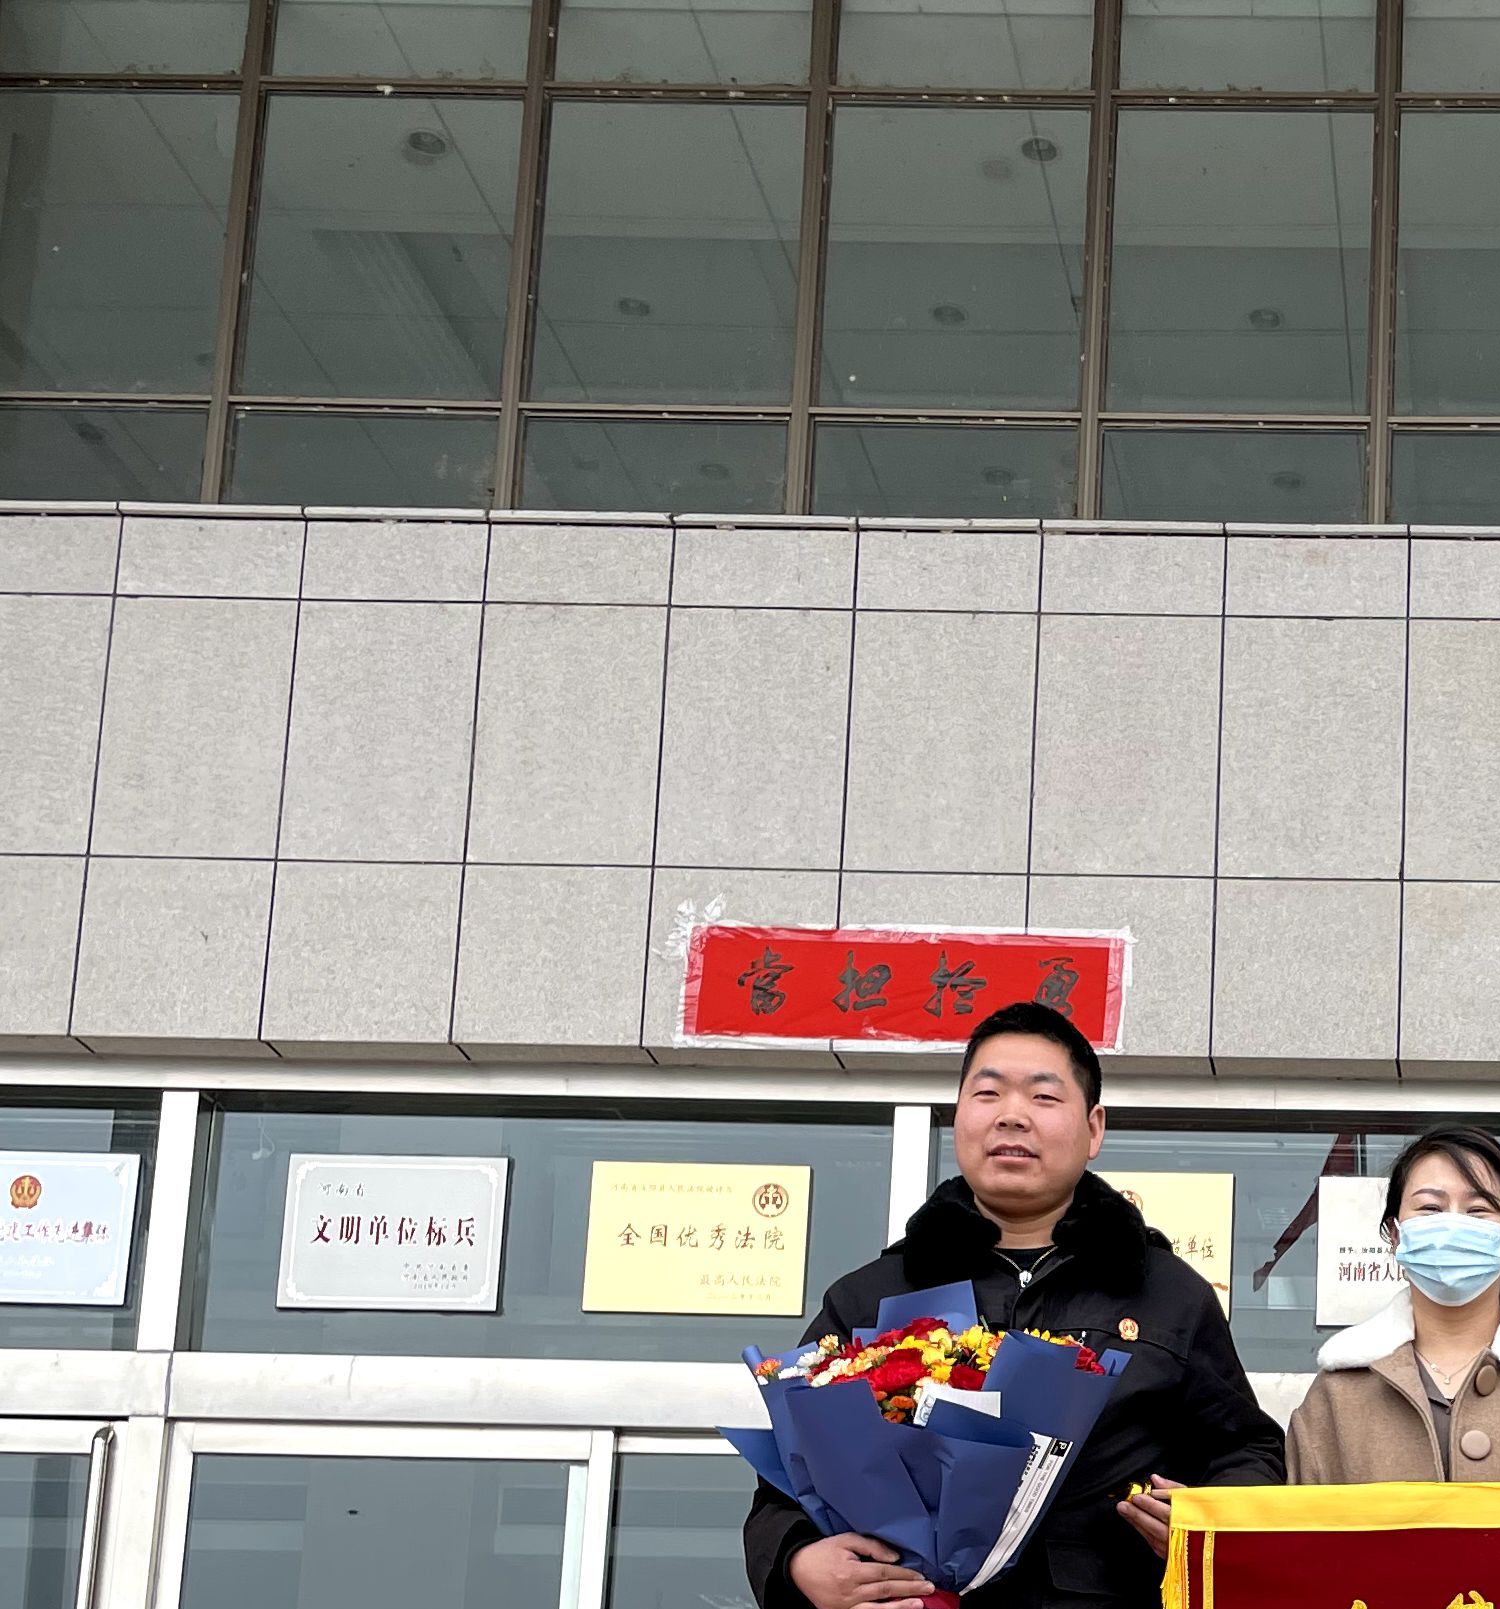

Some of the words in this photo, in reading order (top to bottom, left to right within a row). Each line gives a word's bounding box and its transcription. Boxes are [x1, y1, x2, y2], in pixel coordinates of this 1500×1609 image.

[310, 1214, 477, 1247] 文明单位标兵
[617, 1223, 786, 1251] 全国优秀法院
